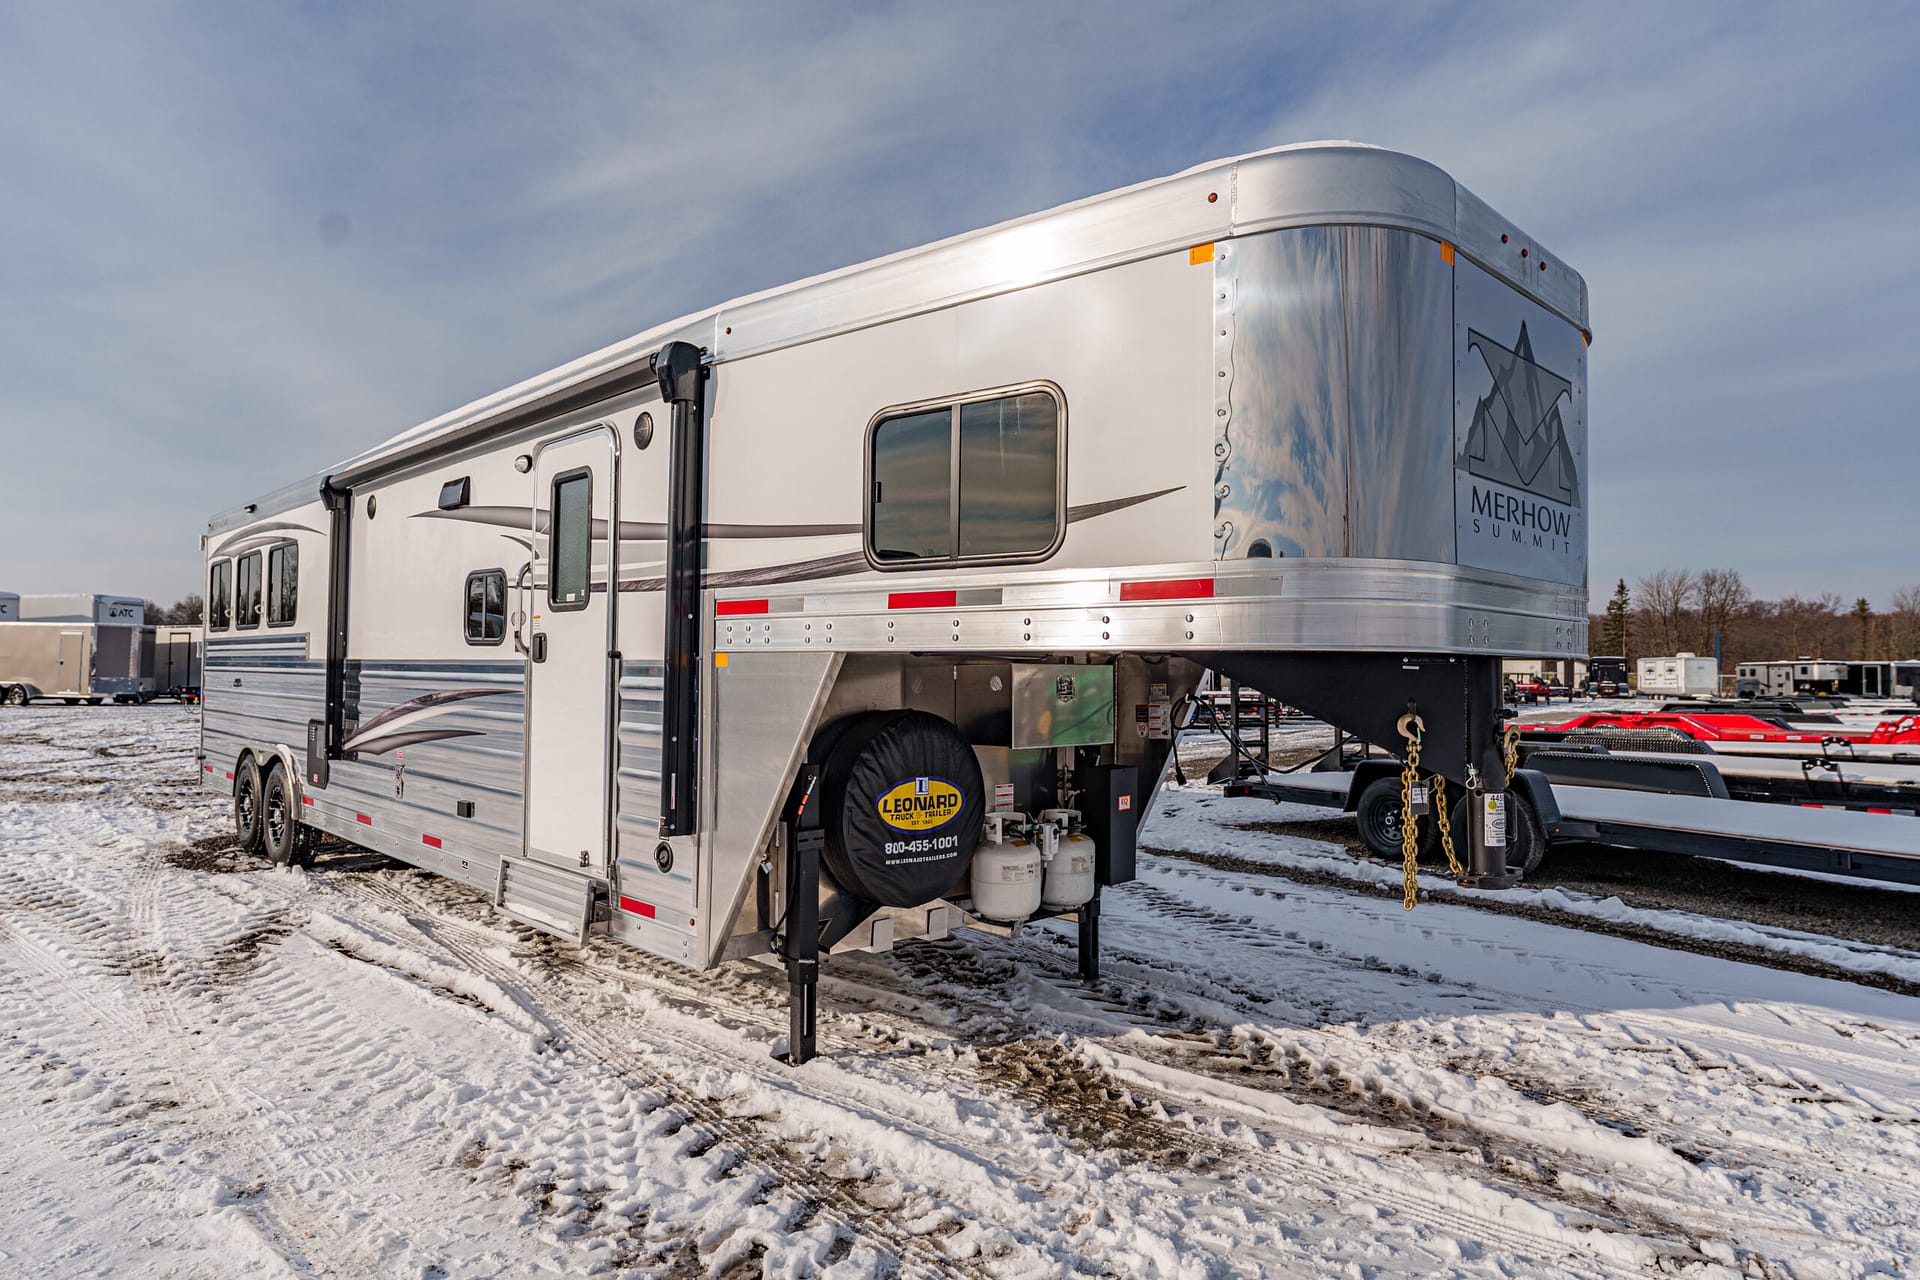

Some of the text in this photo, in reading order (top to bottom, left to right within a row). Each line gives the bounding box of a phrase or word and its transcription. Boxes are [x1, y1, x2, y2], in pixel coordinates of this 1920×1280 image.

[1471, 485, 1571, 538] MERHOW
[1473, 518, 1569, 554] SUMMIT
[118, 608, 134, 618] ATC
[882, 793, 958, 813] LEONARD
[890, 812, 914, 821] TRUCK
[925, 808, 952, 818] TRAILER
[885, 835, 958, 854] 800-455-1001
